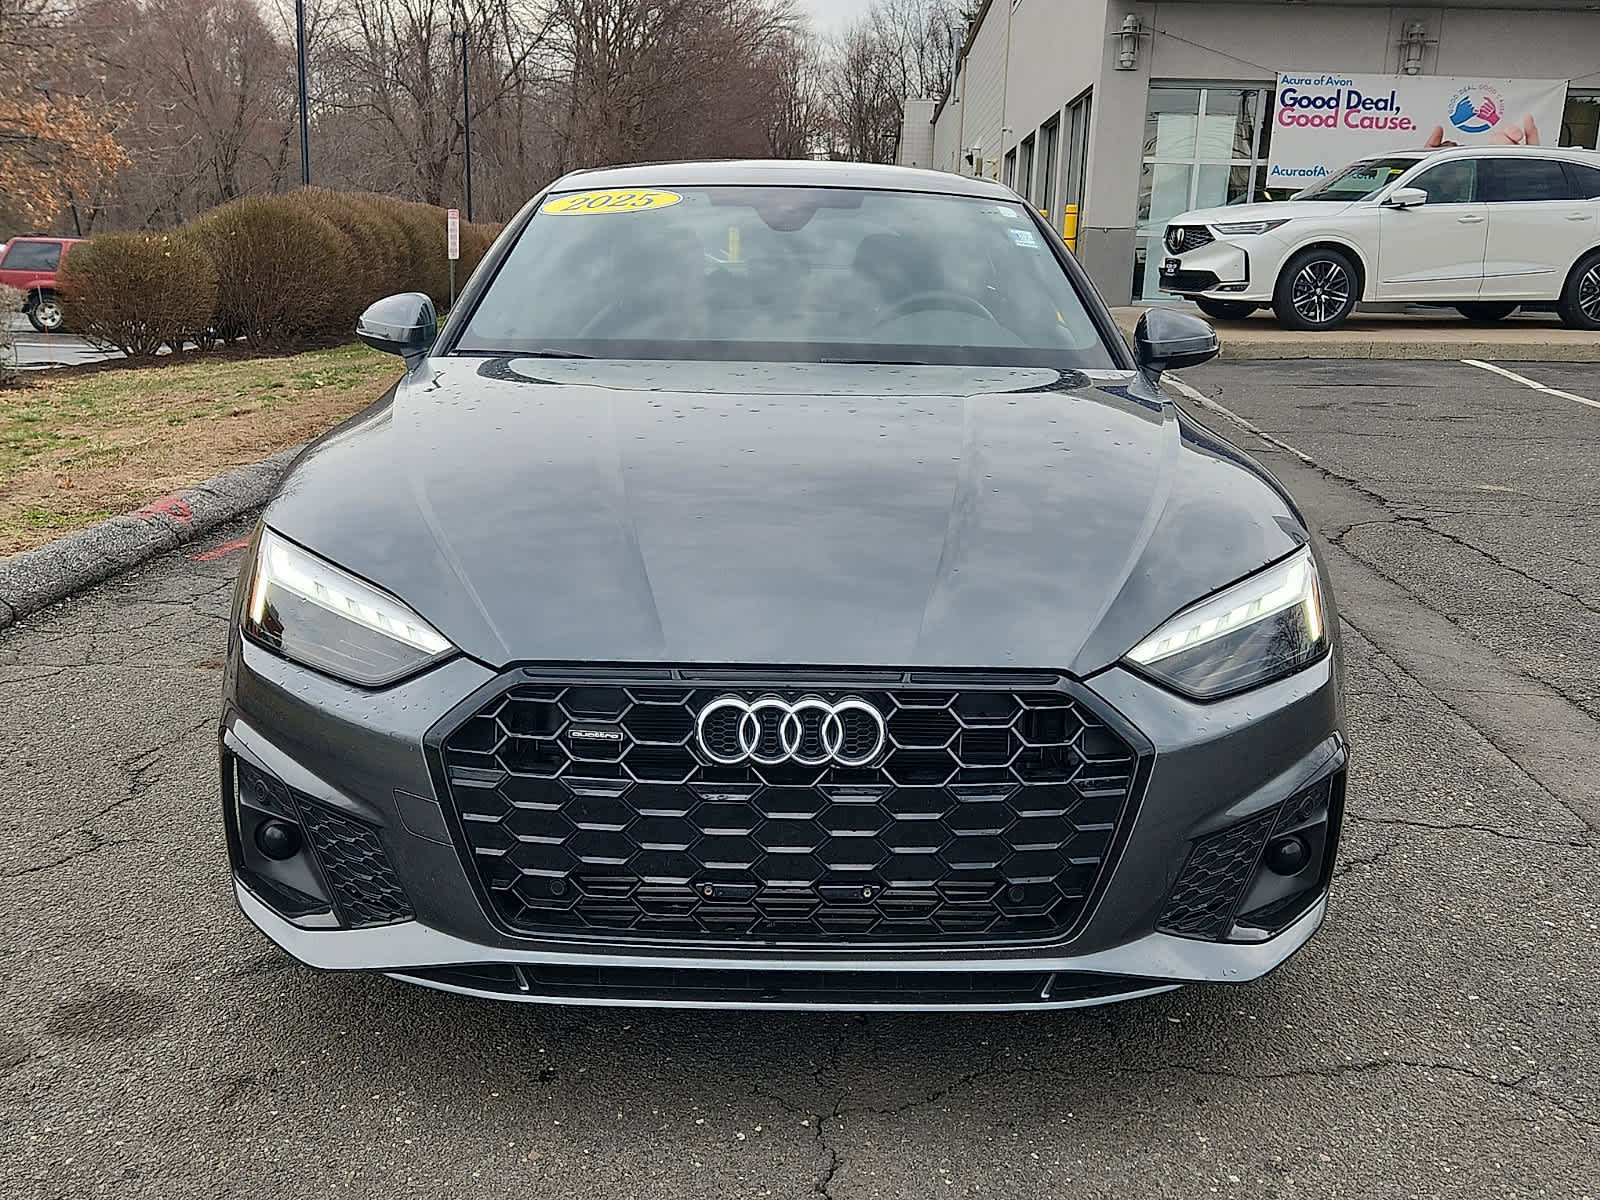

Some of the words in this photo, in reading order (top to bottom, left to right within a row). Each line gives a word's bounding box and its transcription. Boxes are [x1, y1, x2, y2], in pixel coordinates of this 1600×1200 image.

[1280, 75, 1312, 86] Acura
[1314, 75, 1325, 86] of
[1325, 76, 1353, 87] Avon
[1280, 88, 1342, 109] Good
[1345, 90, 1401, 115] Deal,
[1278, 106, 1339, 128] Good
[1343, 108, 1417, 131] Cause.
[559, 193, 660, 212] 2025
[571, 731, 619, 739] quattro
